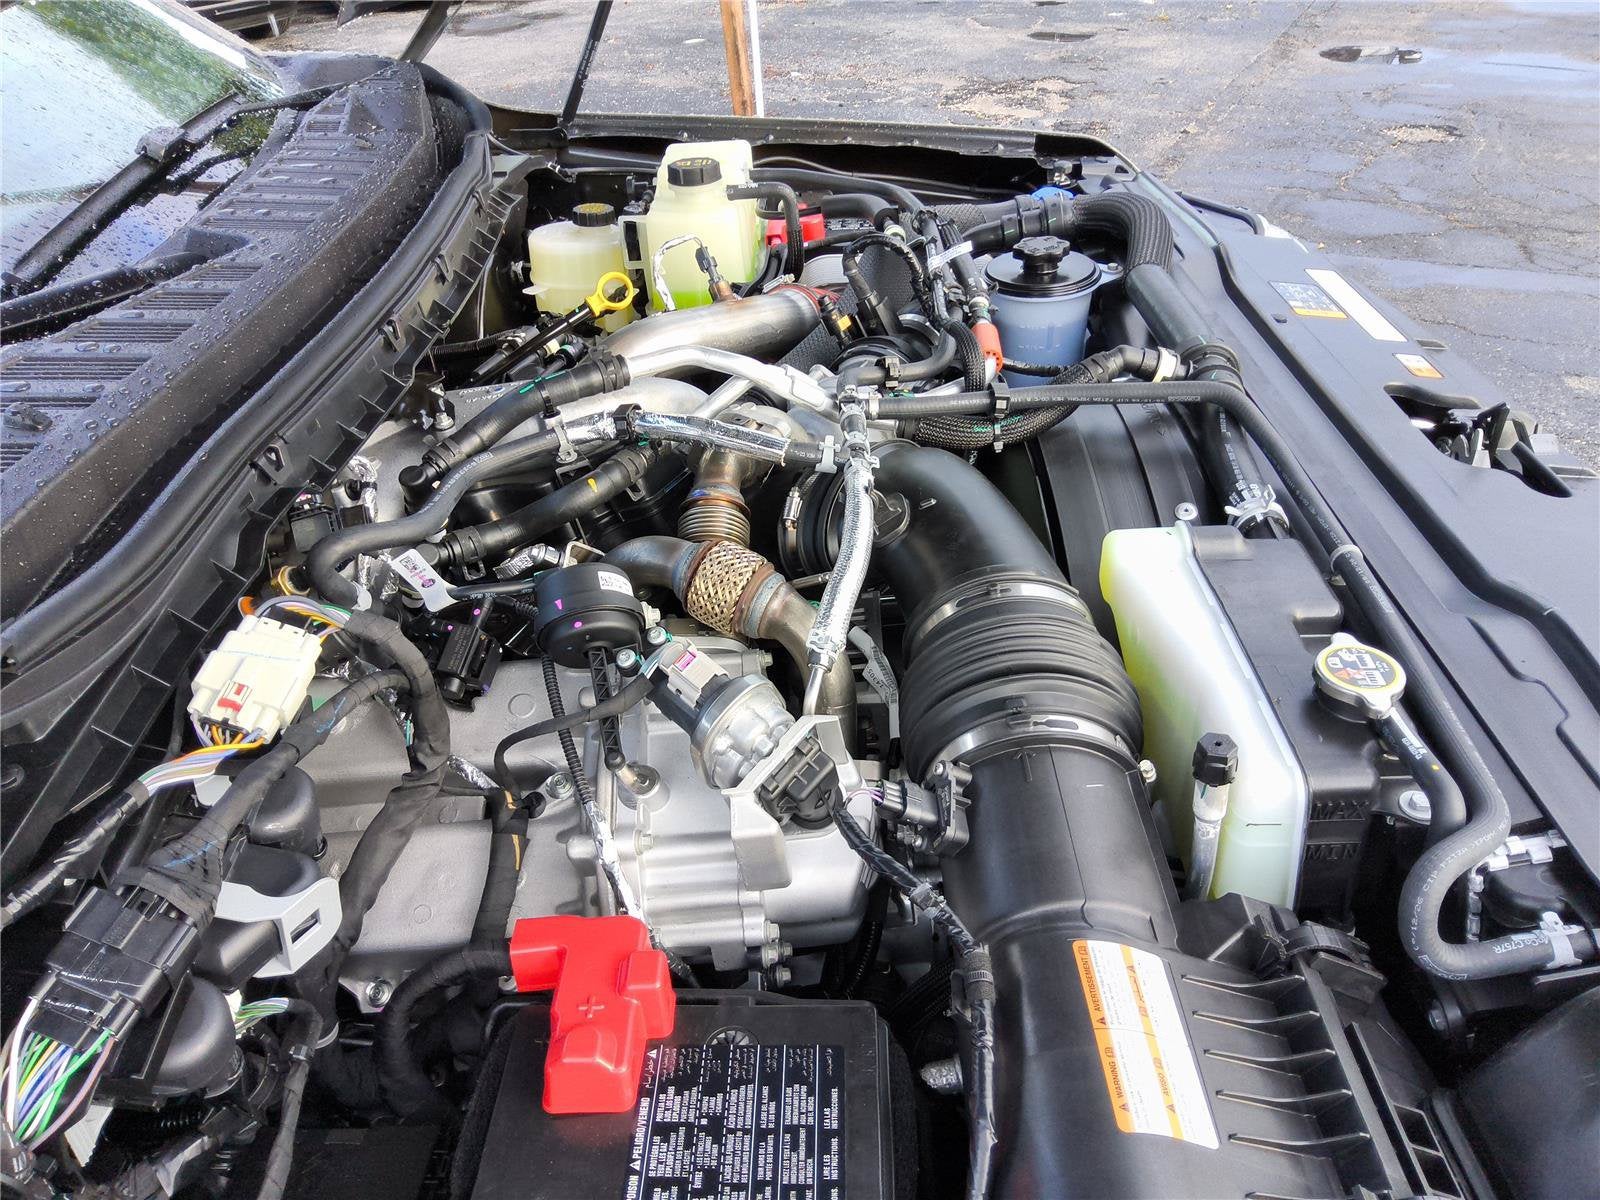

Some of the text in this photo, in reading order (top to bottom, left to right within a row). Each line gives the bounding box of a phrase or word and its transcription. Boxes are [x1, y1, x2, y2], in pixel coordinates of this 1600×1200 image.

[1311, 801, 1367, 820] MAX
[1082, 957, 1101, 1012] AVERTISSEMENT
[1105, 1061, 1123, 1098] WARNING
[632, 1098, 650, 1159] PELIGRO/VENENO
